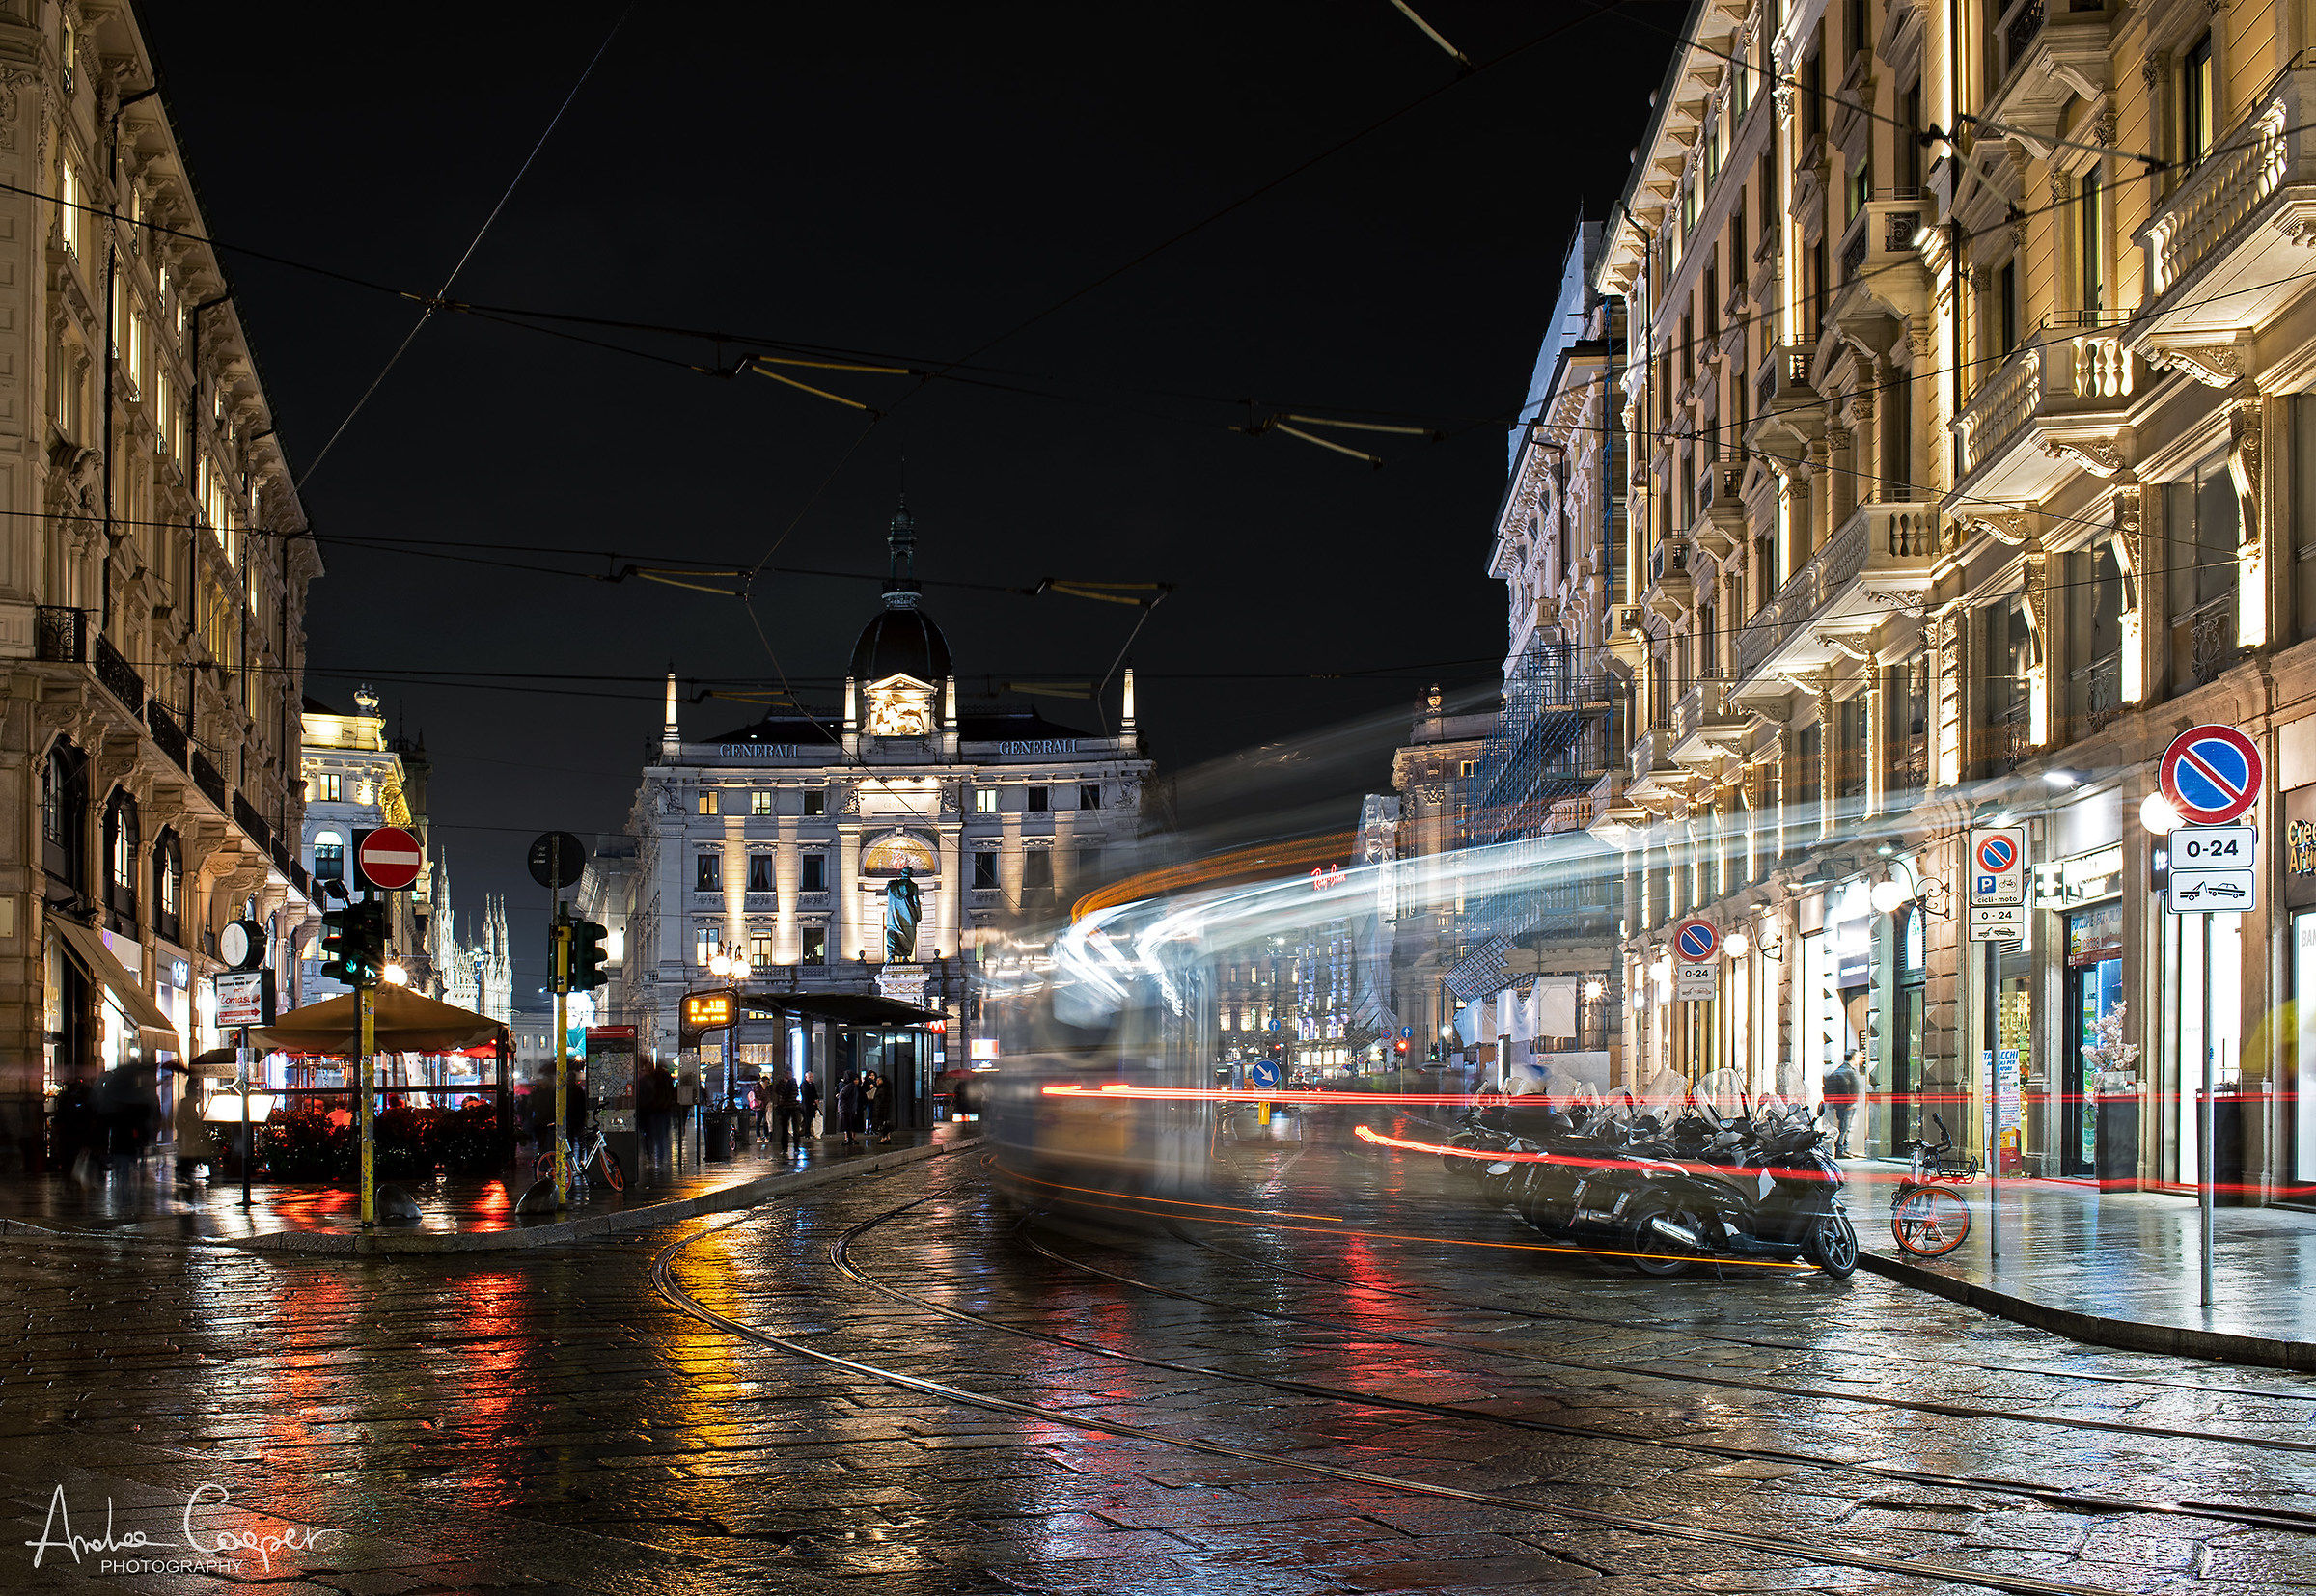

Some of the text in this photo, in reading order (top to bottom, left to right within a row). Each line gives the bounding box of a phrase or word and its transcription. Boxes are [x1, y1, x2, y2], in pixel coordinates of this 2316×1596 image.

[719, 743, 798, 757] GENERALI
[999, 739, 1077, 756] GENERALI
[2187, 839, 2239, 858] 0-24
[2288, 844, 2316, 874] Arti
[1310, 863, 1347, 891] Ray-Ban
[1685, 969, 1709, 977] 0-24
[1983, 1050, 2019, 1060] TACCHI
